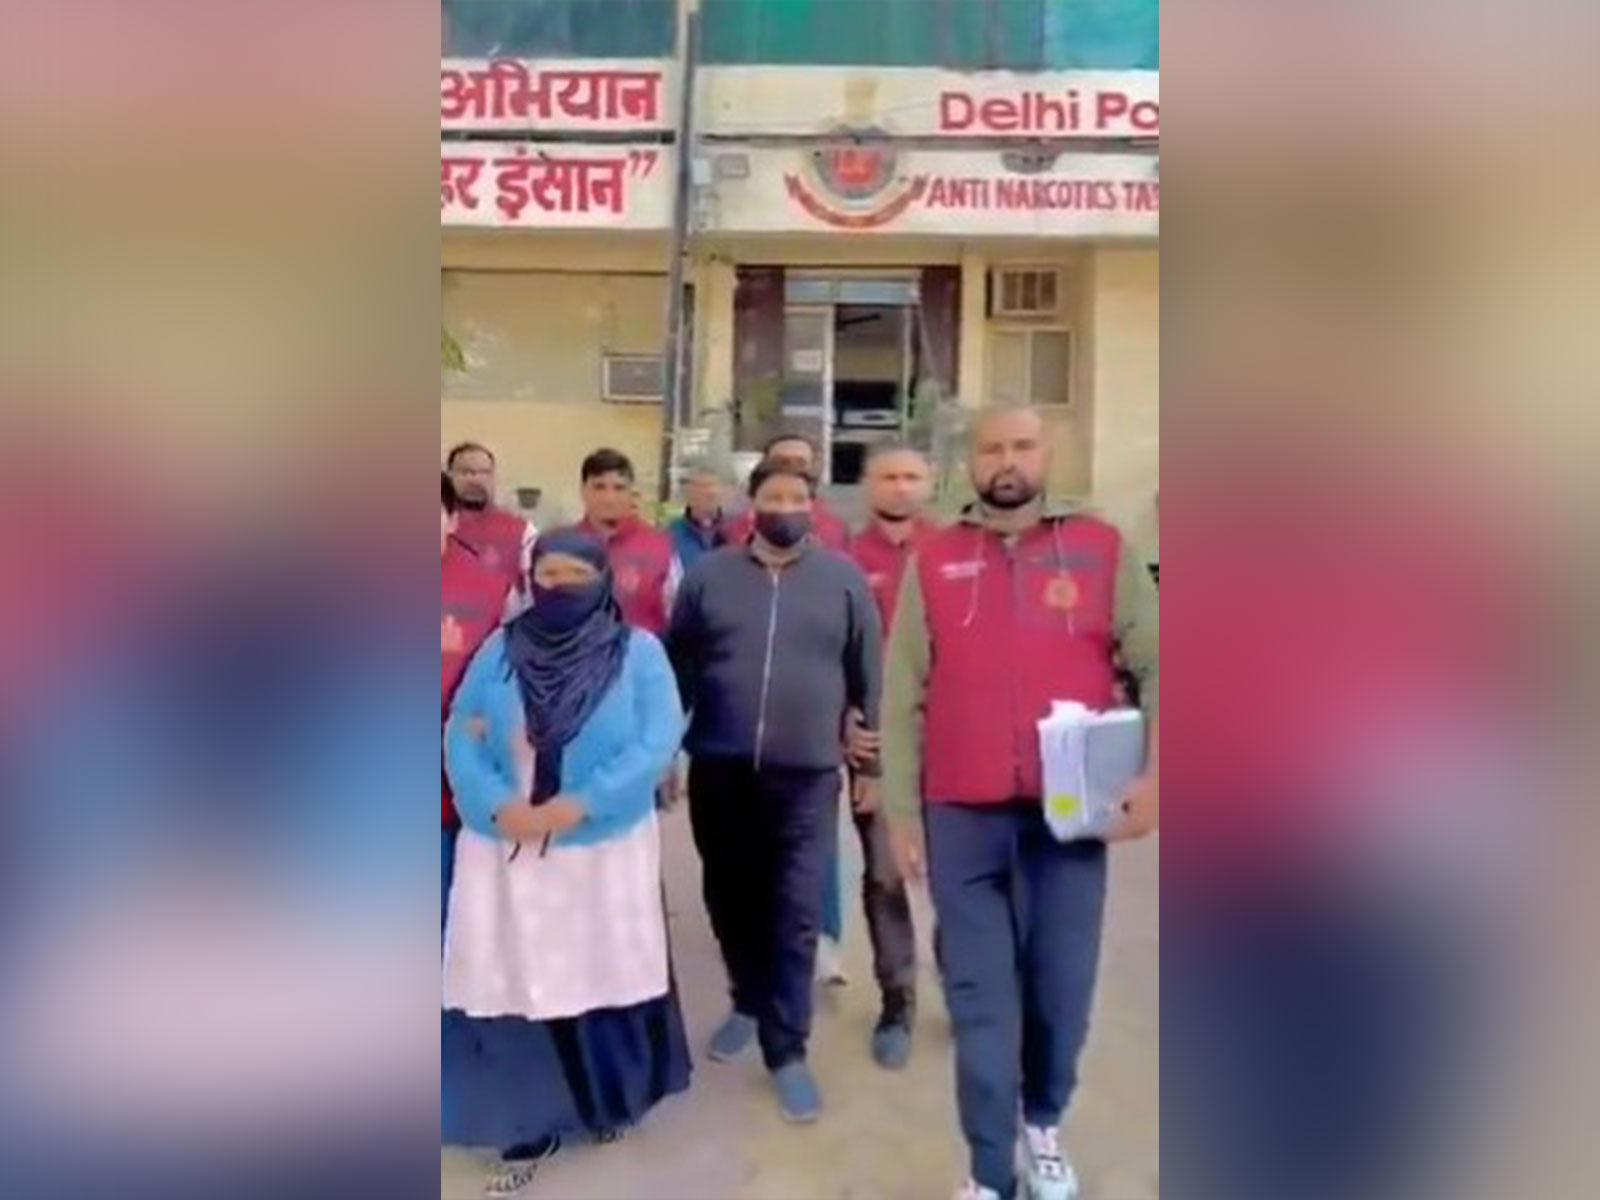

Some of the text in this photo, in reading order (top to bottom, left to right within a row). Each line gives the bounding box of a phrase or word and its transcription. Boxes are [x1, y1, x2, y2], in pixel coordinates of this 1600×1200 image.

[441, 60, 661, 121] अभियान
[940, 90, 1159, 130] Delhi Po
[926, 178, 988, 208] ANTI
[996, 179, 1117, 210] NARCOTICS
